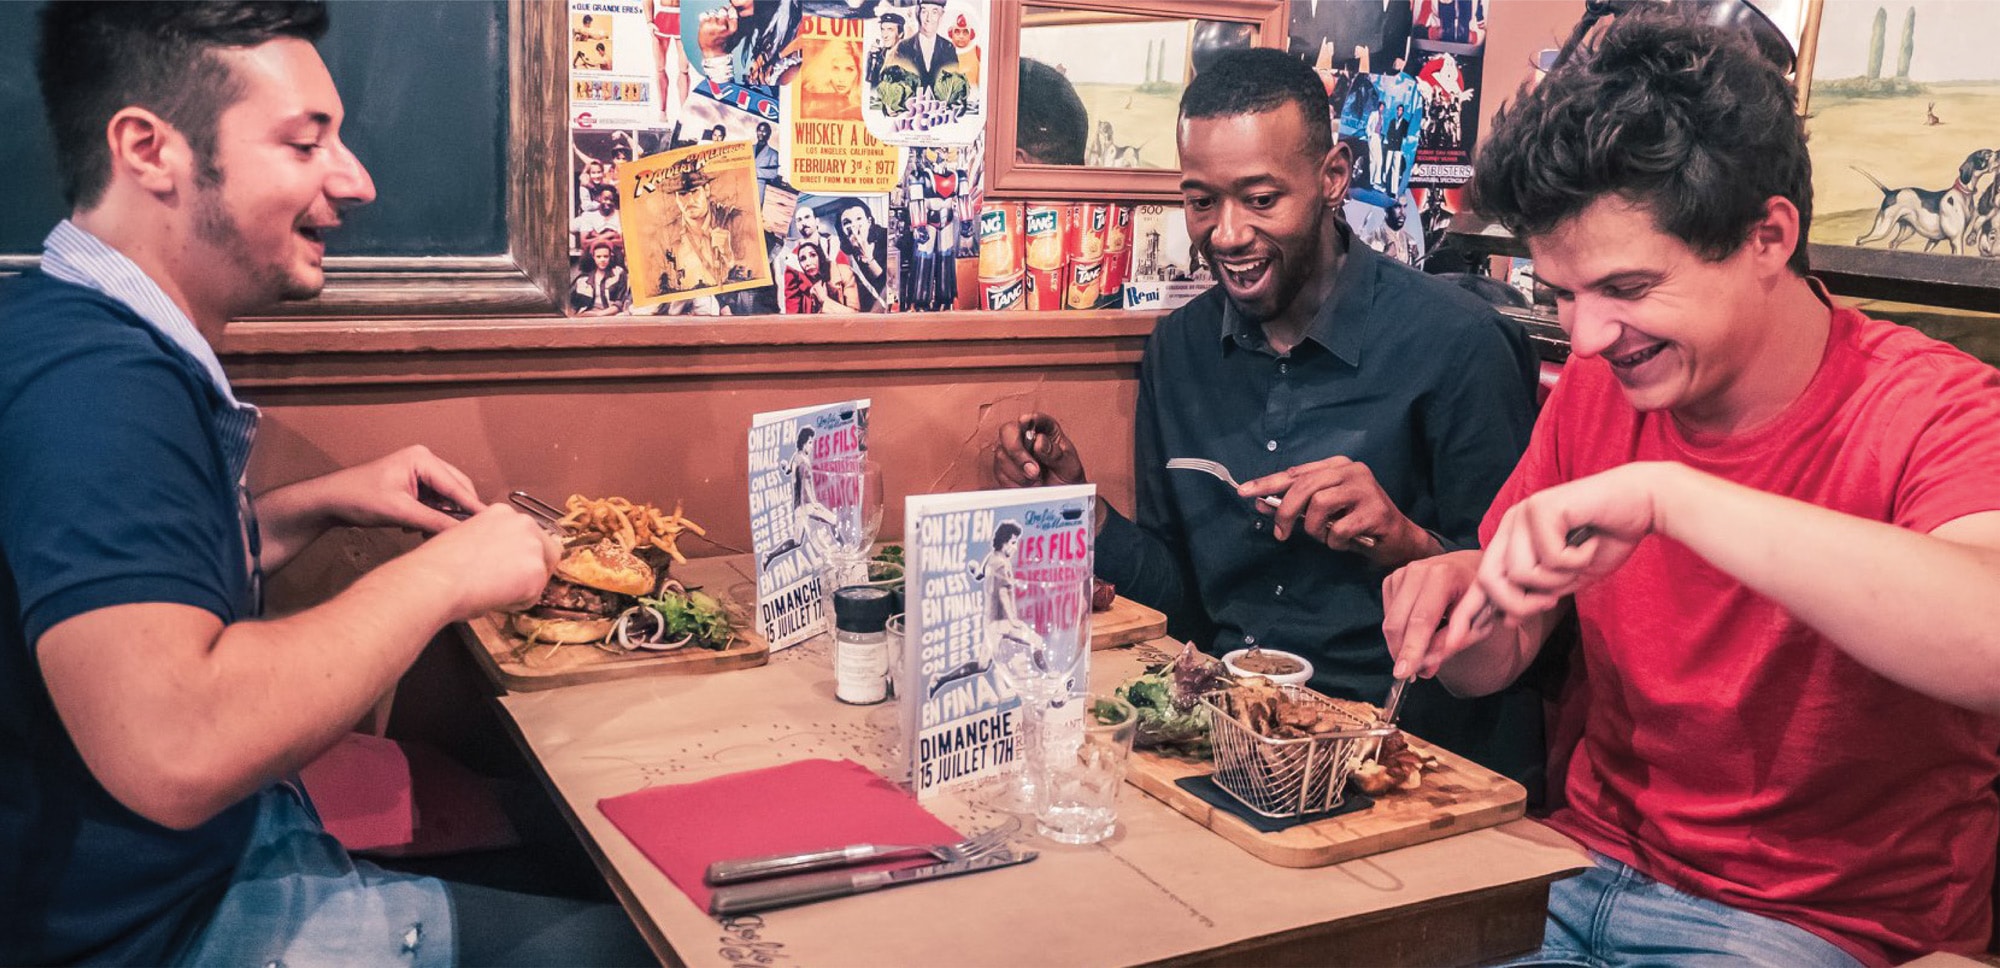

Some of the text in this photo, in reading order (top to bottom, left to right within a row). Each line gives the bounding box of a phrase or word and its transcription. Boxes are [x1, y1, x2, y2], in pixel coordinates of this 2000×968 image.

[592, 4, 621, 13] GRANDE
[802, 15, 863, 38] BLON
[794, 122, 844, 146] WHISKEY
[850, 123, 858, 146] A
[805, 146, 818, 155] LOS
[850, 147, 884, 157] CALIFORNIA
[793, 157, 847, 174] FEBRUARY
[875, 160, 896, 175] 1977
[799, 175, 890, 186] DIRECT FROM NEW YORK CITY
[1026, 213, 1054, 234] TANG
[990, 284, 1022, 310] TANG
[748, 429, 764, 452] ON
[782, 418, 798, 446] EN
[812, 424, 858, 460] LES FILS
[920, 509, 996, 546] ON EST EN
[920, 542, 968, 574] FINALE
[1017, 527, 1087, 568] LES FILS
[925, 576, 946, 598] ON
[777, 603, 811, 640] JUILLET
[920, 597, 944, 629] EN
[921, 626, 946, 646] ON
[921, 641, 946, 661] ON
[921, 657, 946, 676] ON
[920, 711, 1014, 764] DIMANCHE
[919, 762, 933, 791] 15
[936, 745, 988, 785] JUILLET
[992, 736, 1015, 766] 17H
